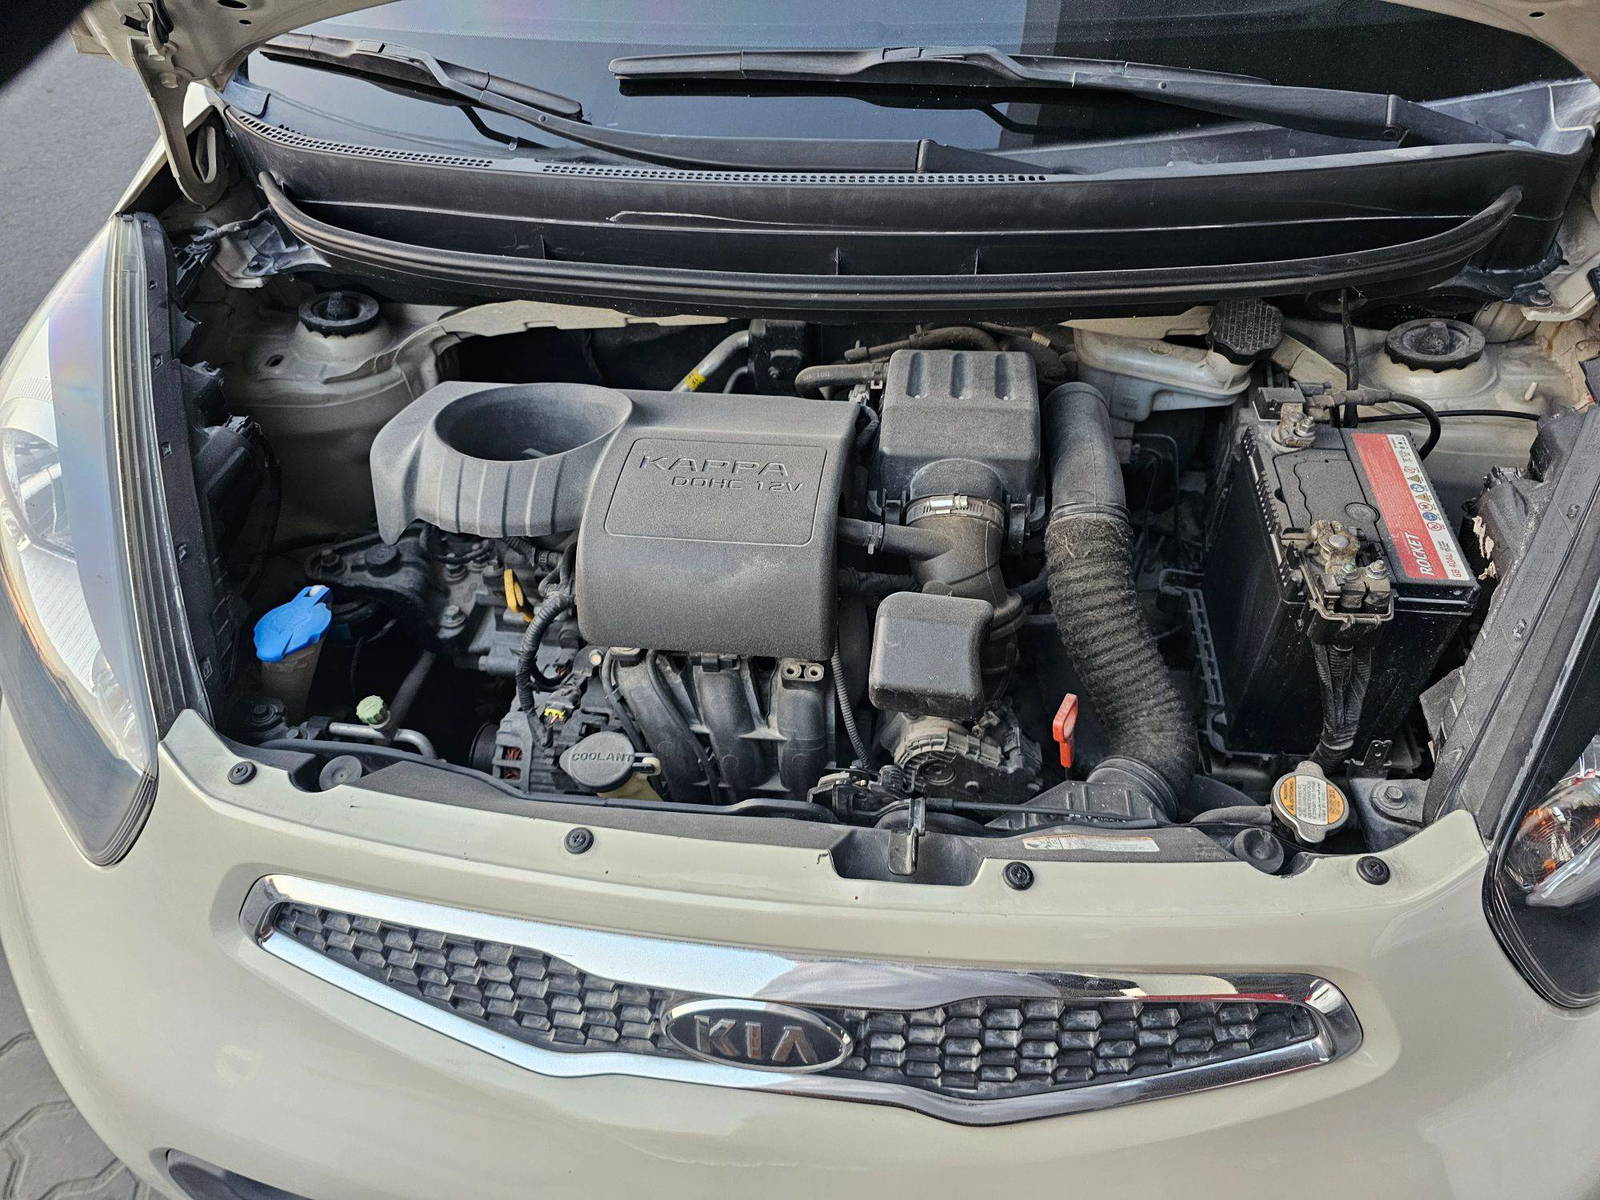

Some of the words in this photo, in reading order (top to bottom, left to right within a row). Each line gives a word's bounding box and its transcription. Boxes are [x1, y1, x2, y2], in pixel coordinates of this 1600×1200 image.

[639, 455, 788, 477] KAPPA
[671, 476, 744, 490] DOHC
[756, 480, 803, 493] 12V
[1404, 530, 1436, 576] ROCKET
[572, 751, 634, 762] COOLANT
[693, 1014, 818, 1065] KIA
